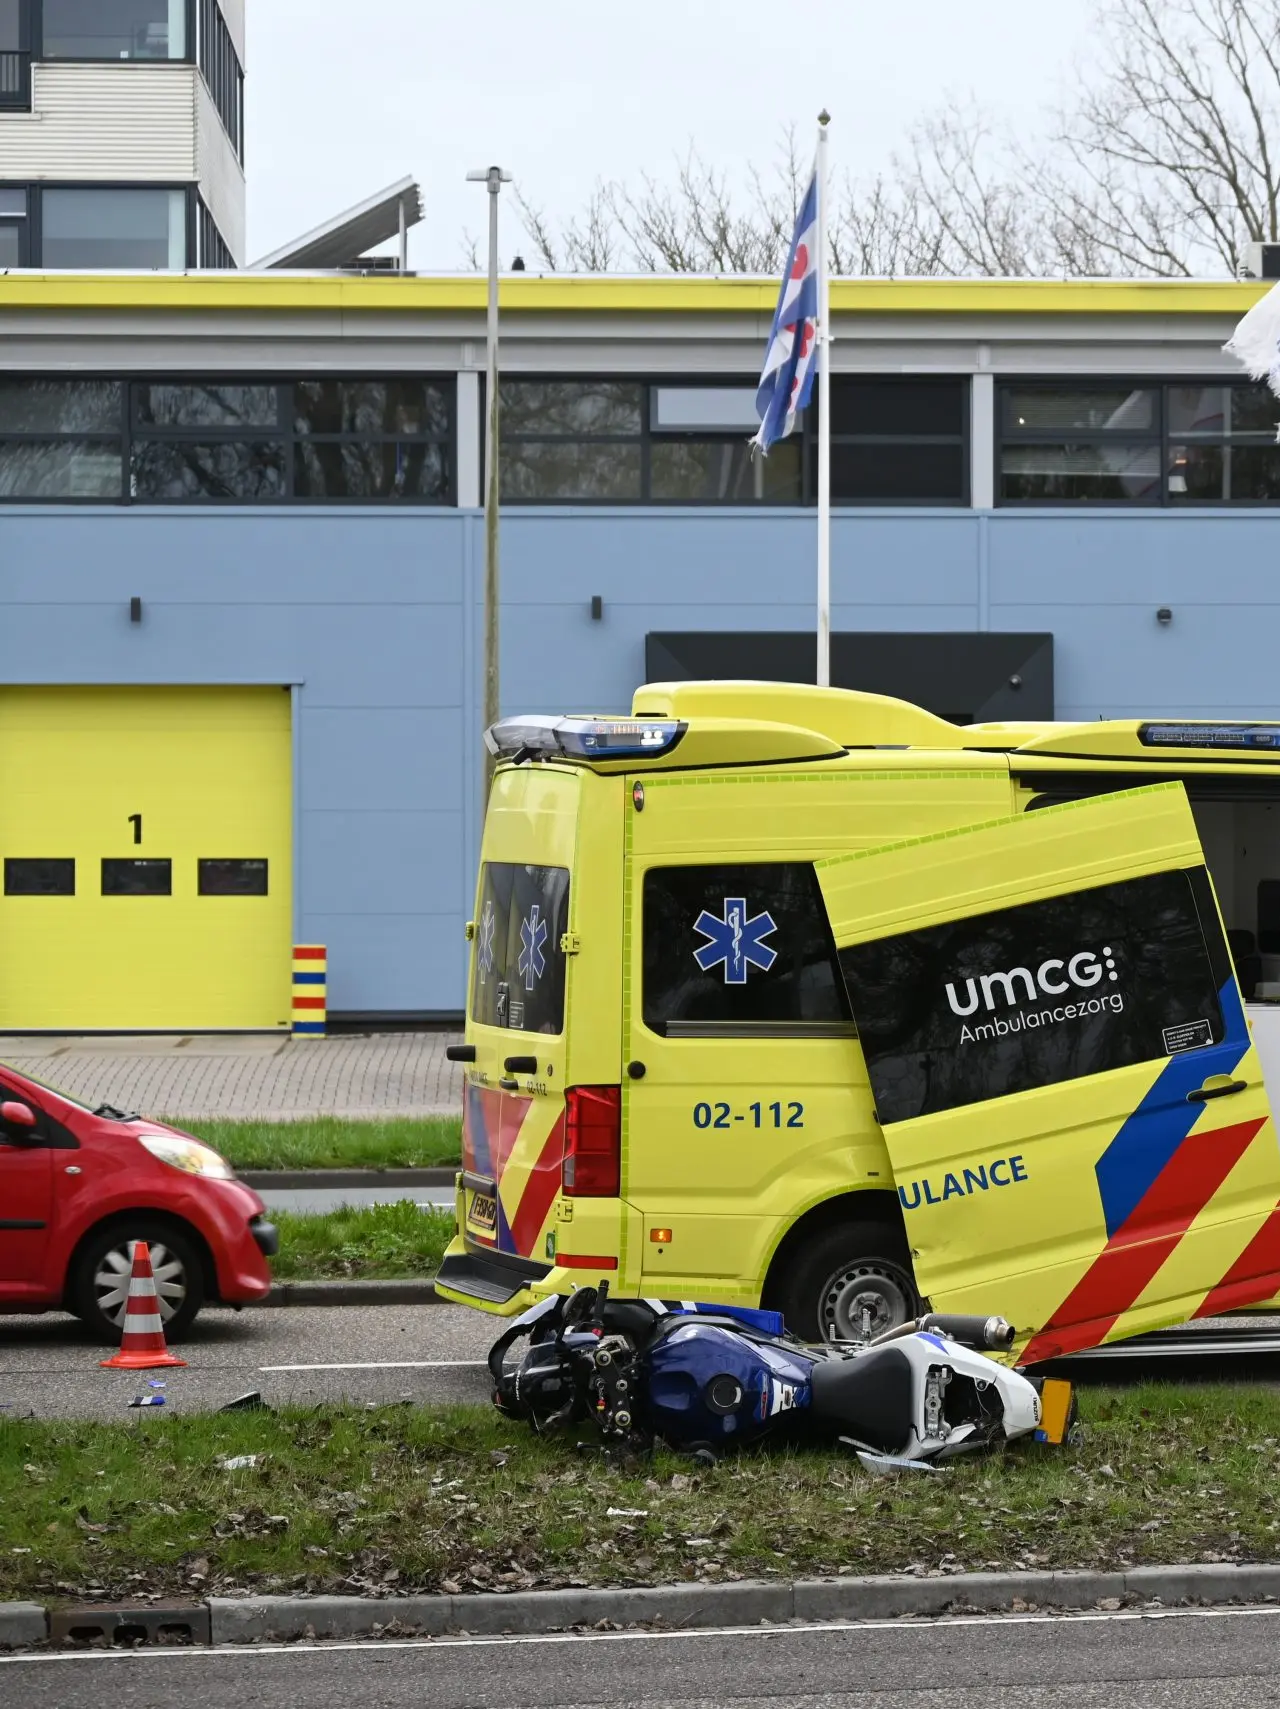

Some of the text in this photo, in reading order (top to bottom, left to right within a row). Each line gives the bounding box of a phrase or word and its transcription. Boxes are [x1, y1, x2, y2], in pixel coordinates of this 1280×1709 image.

[128, 814, 142, 844] 1
[960, 993, 1124, 1044] Ambulancezorg
[693, 1101, 804, 1129] 02-112
[1032, 1396, 1040, 1422] SUZUKI
